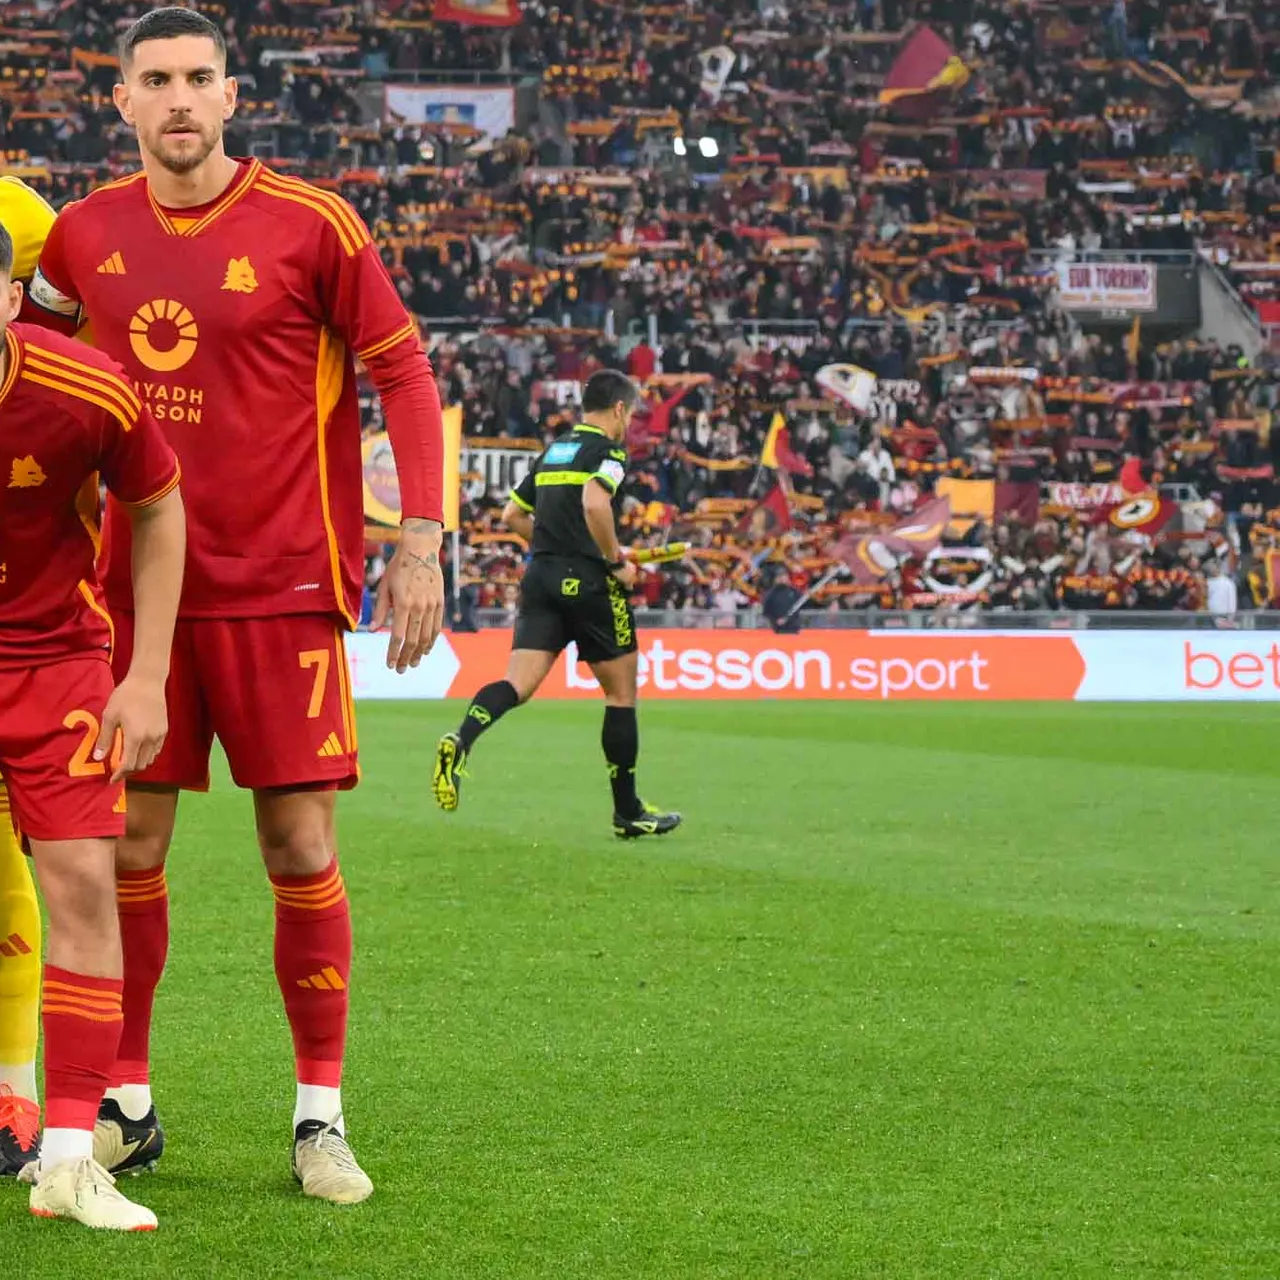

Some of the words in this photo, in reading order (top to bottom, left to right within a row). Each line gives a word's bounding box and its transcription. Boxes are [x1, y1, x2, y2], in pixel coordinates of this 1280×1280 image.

[134, 381, 203, 405] IYADH
[146, 402, 202, 424] SON
[298, 648, 330, 718] 7
